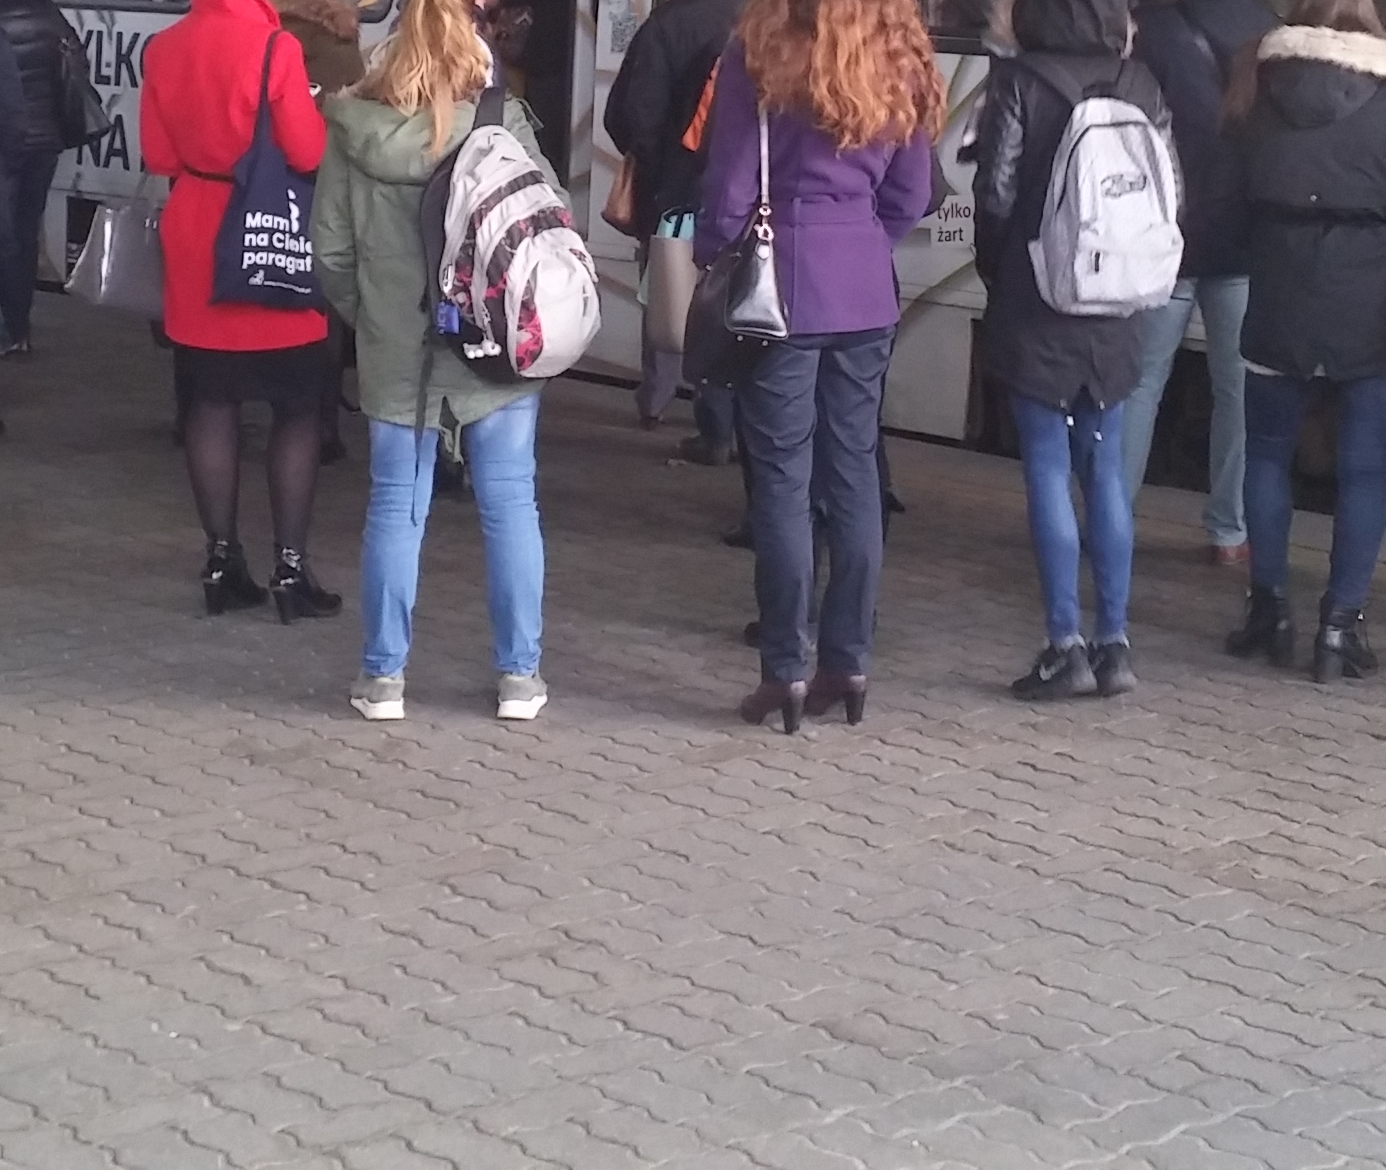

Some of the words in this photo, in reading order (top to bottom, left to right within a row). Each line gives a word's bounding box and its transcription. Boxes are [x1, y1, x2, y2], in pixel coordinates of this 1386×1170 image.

[245, 211, 289, 231] Mam
[937, 202, 971, 223] tylko
[244, 233, 269, 247] na
[937, 226, 964, 242] żart
